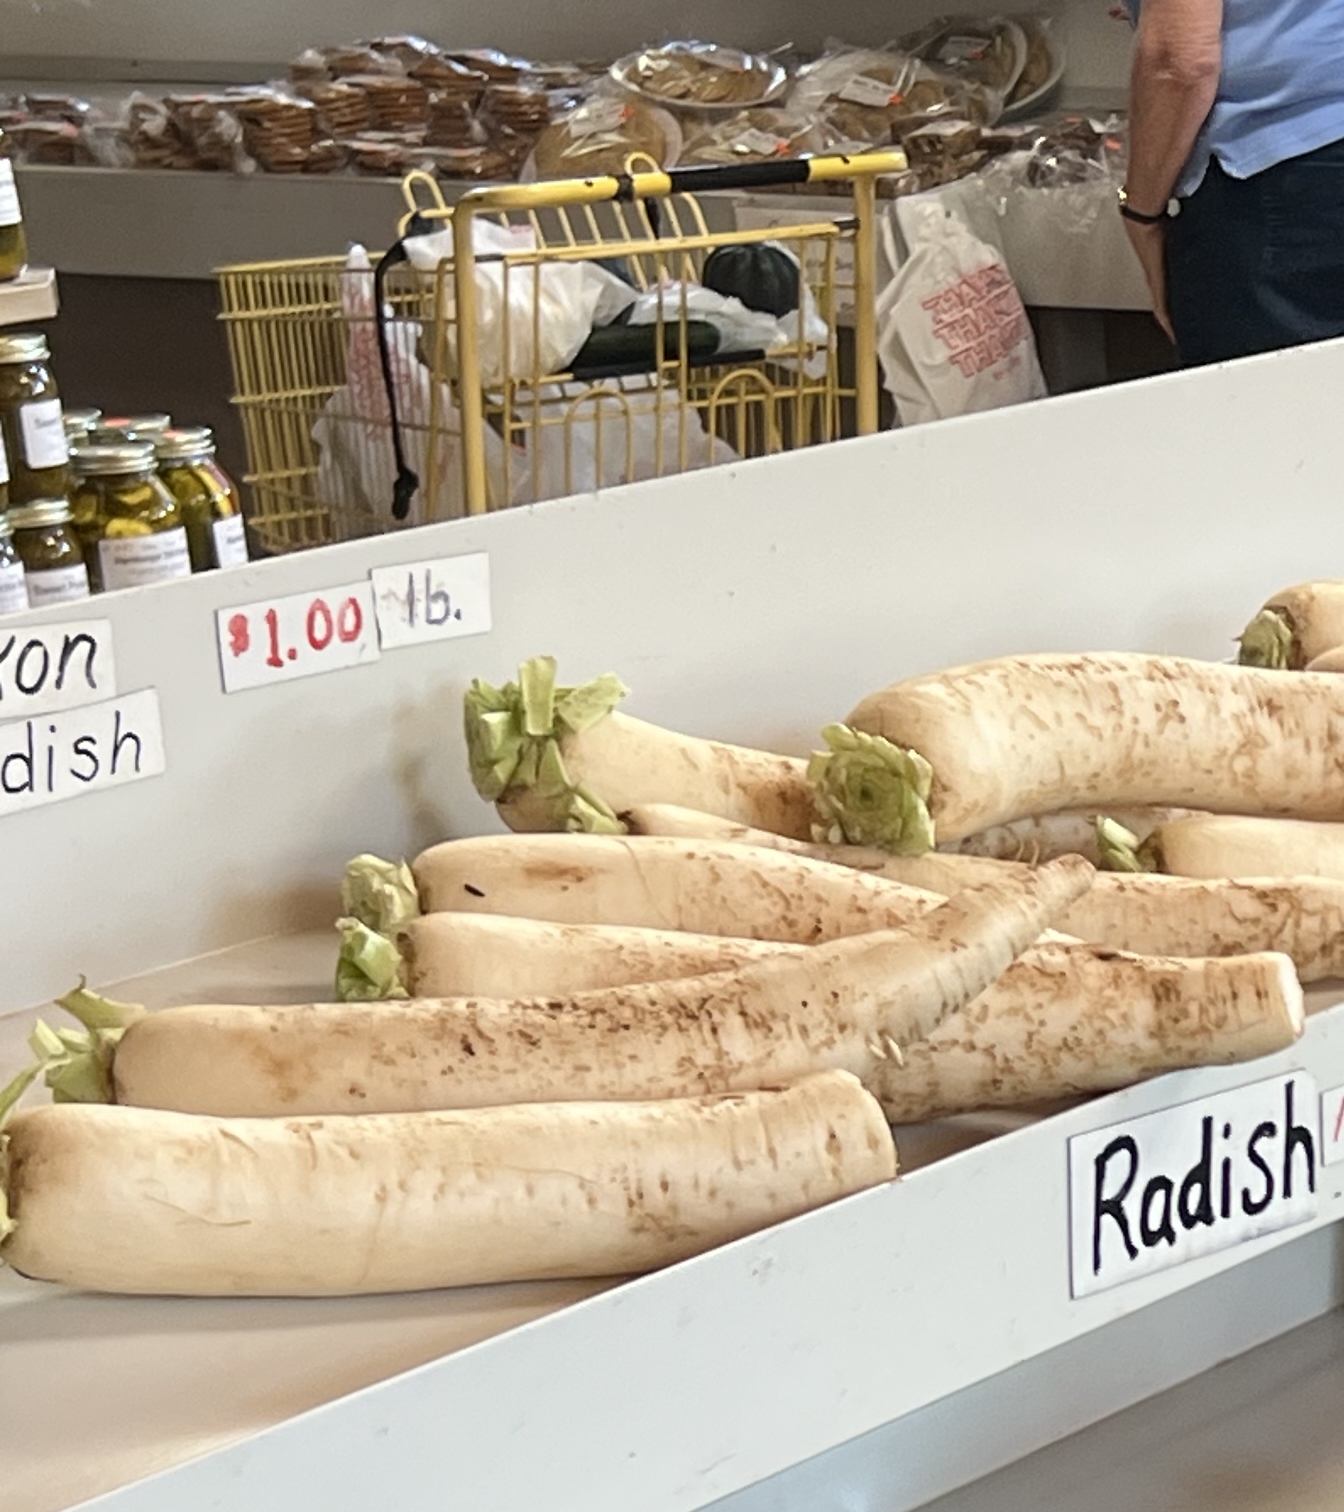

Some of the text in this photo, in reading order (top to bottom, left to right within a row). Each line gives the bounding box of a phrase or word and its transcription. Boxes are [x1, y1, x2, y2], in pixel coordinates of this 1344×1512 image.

[228, 569, 463, 668] $1.00 lb.
[1093, 1080, 1315, 1276] Radish
